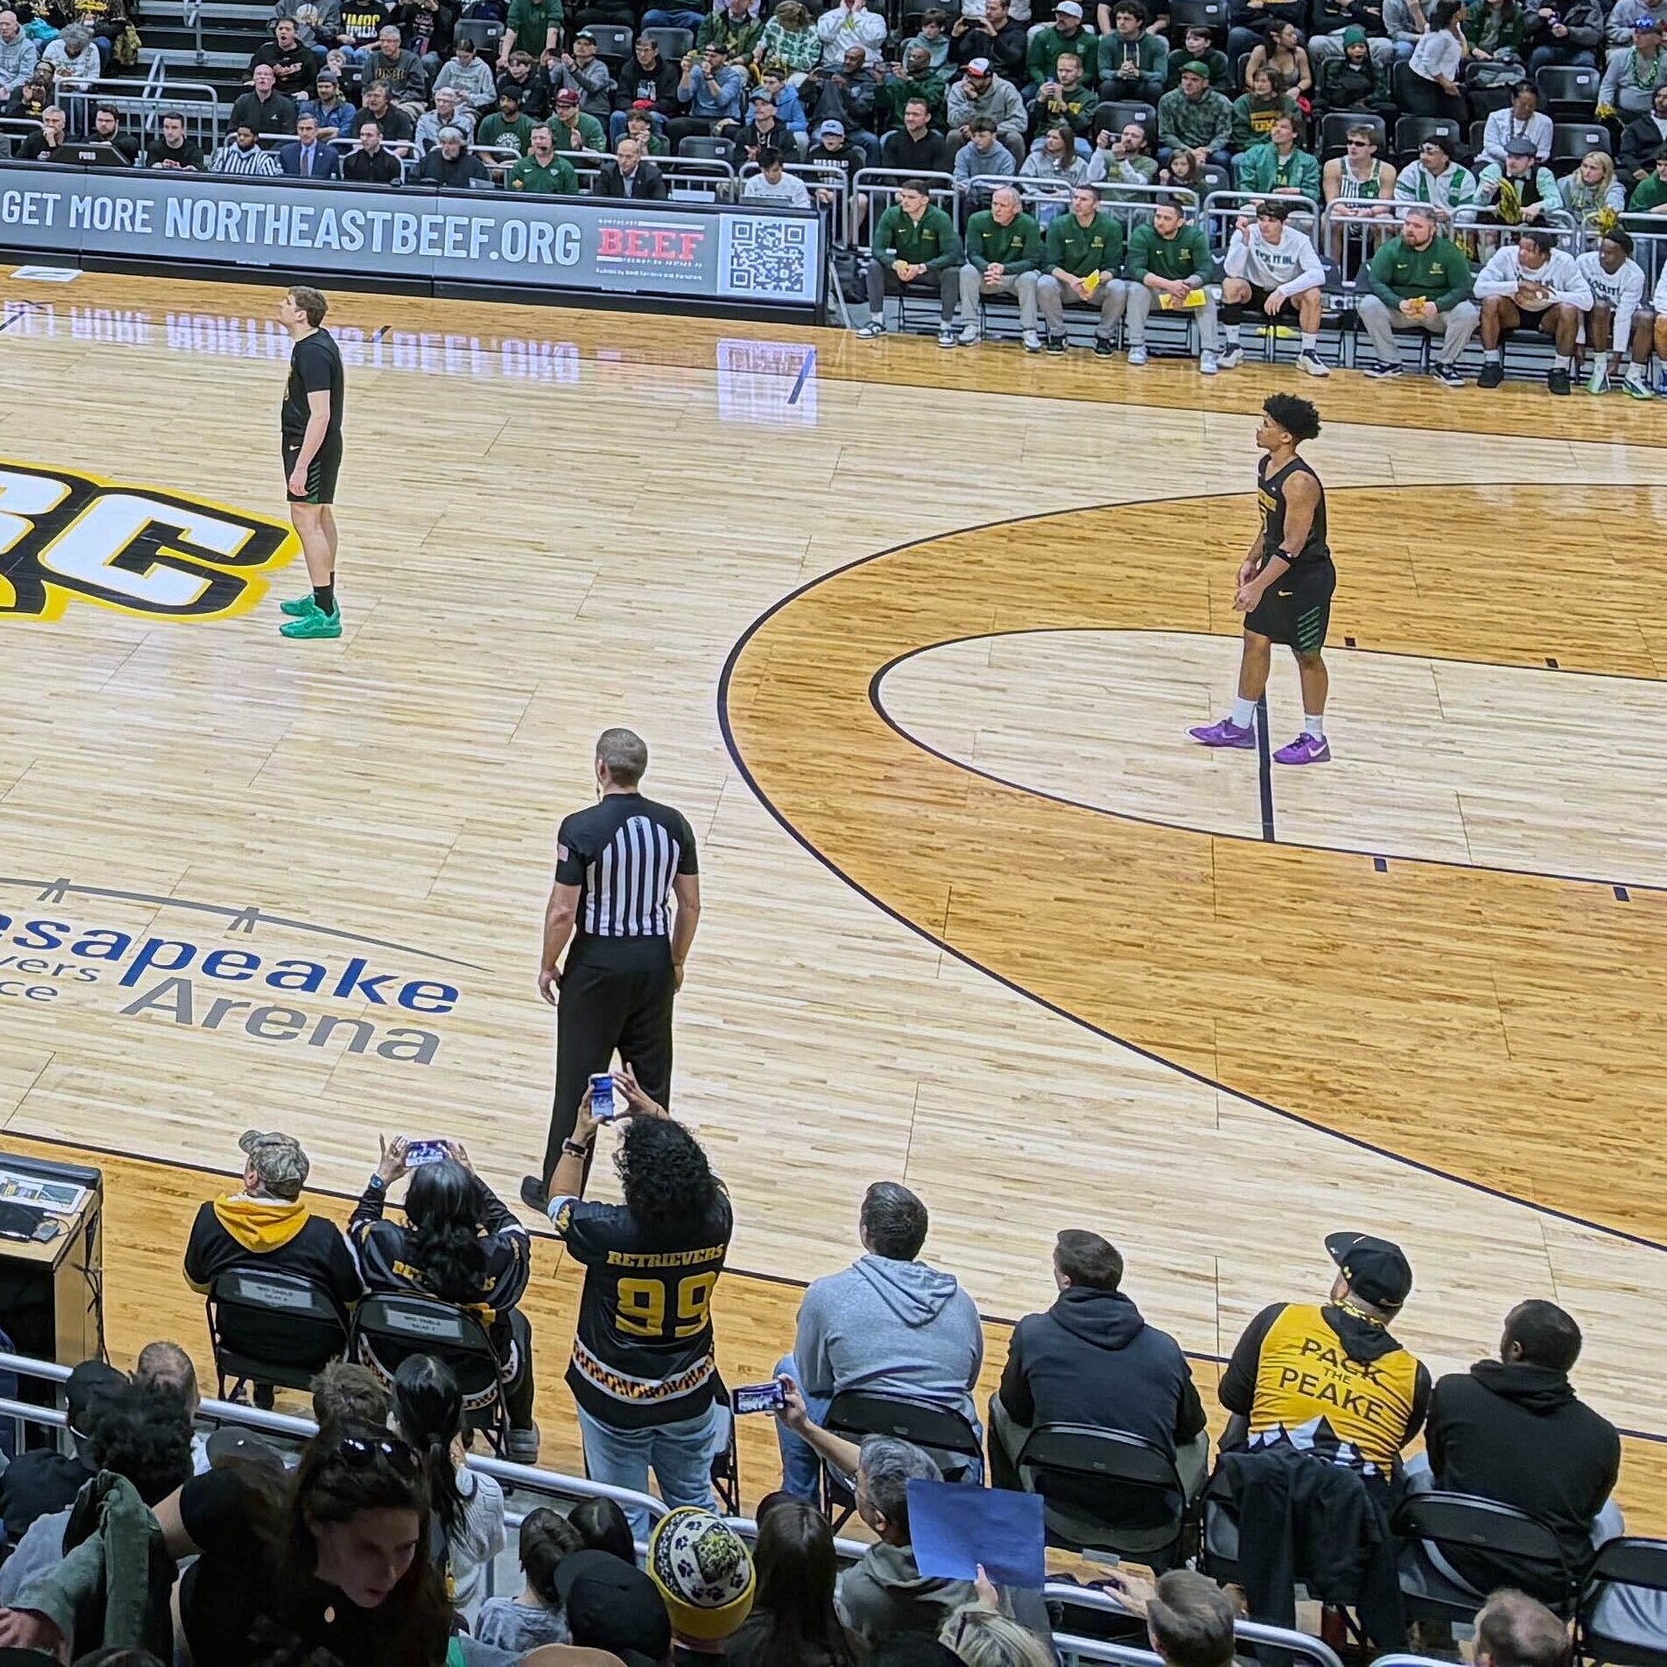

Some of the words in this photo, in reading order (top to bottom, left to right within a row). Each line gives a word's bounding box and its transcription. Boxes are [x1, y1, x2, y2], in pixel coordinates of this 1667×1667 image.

[1, 189, 62, 226] GET
[69, 194, 155, 234] MORE
[165, 196, 582, 266] NORTHEASTBEEF.ORG
[597, 227, 705, 261] BEEF
[119, 977, 444, 1067] Arena
[606, 1242, 725, 1269] RETRIEVERS
[614, 1269, 718, 1339] 99
[1300, 1337, 1388, 1388] PACK
[1323, 1365, 1353, 1386] THE
[1278, 1366, 1385, 1426] PEAKE
